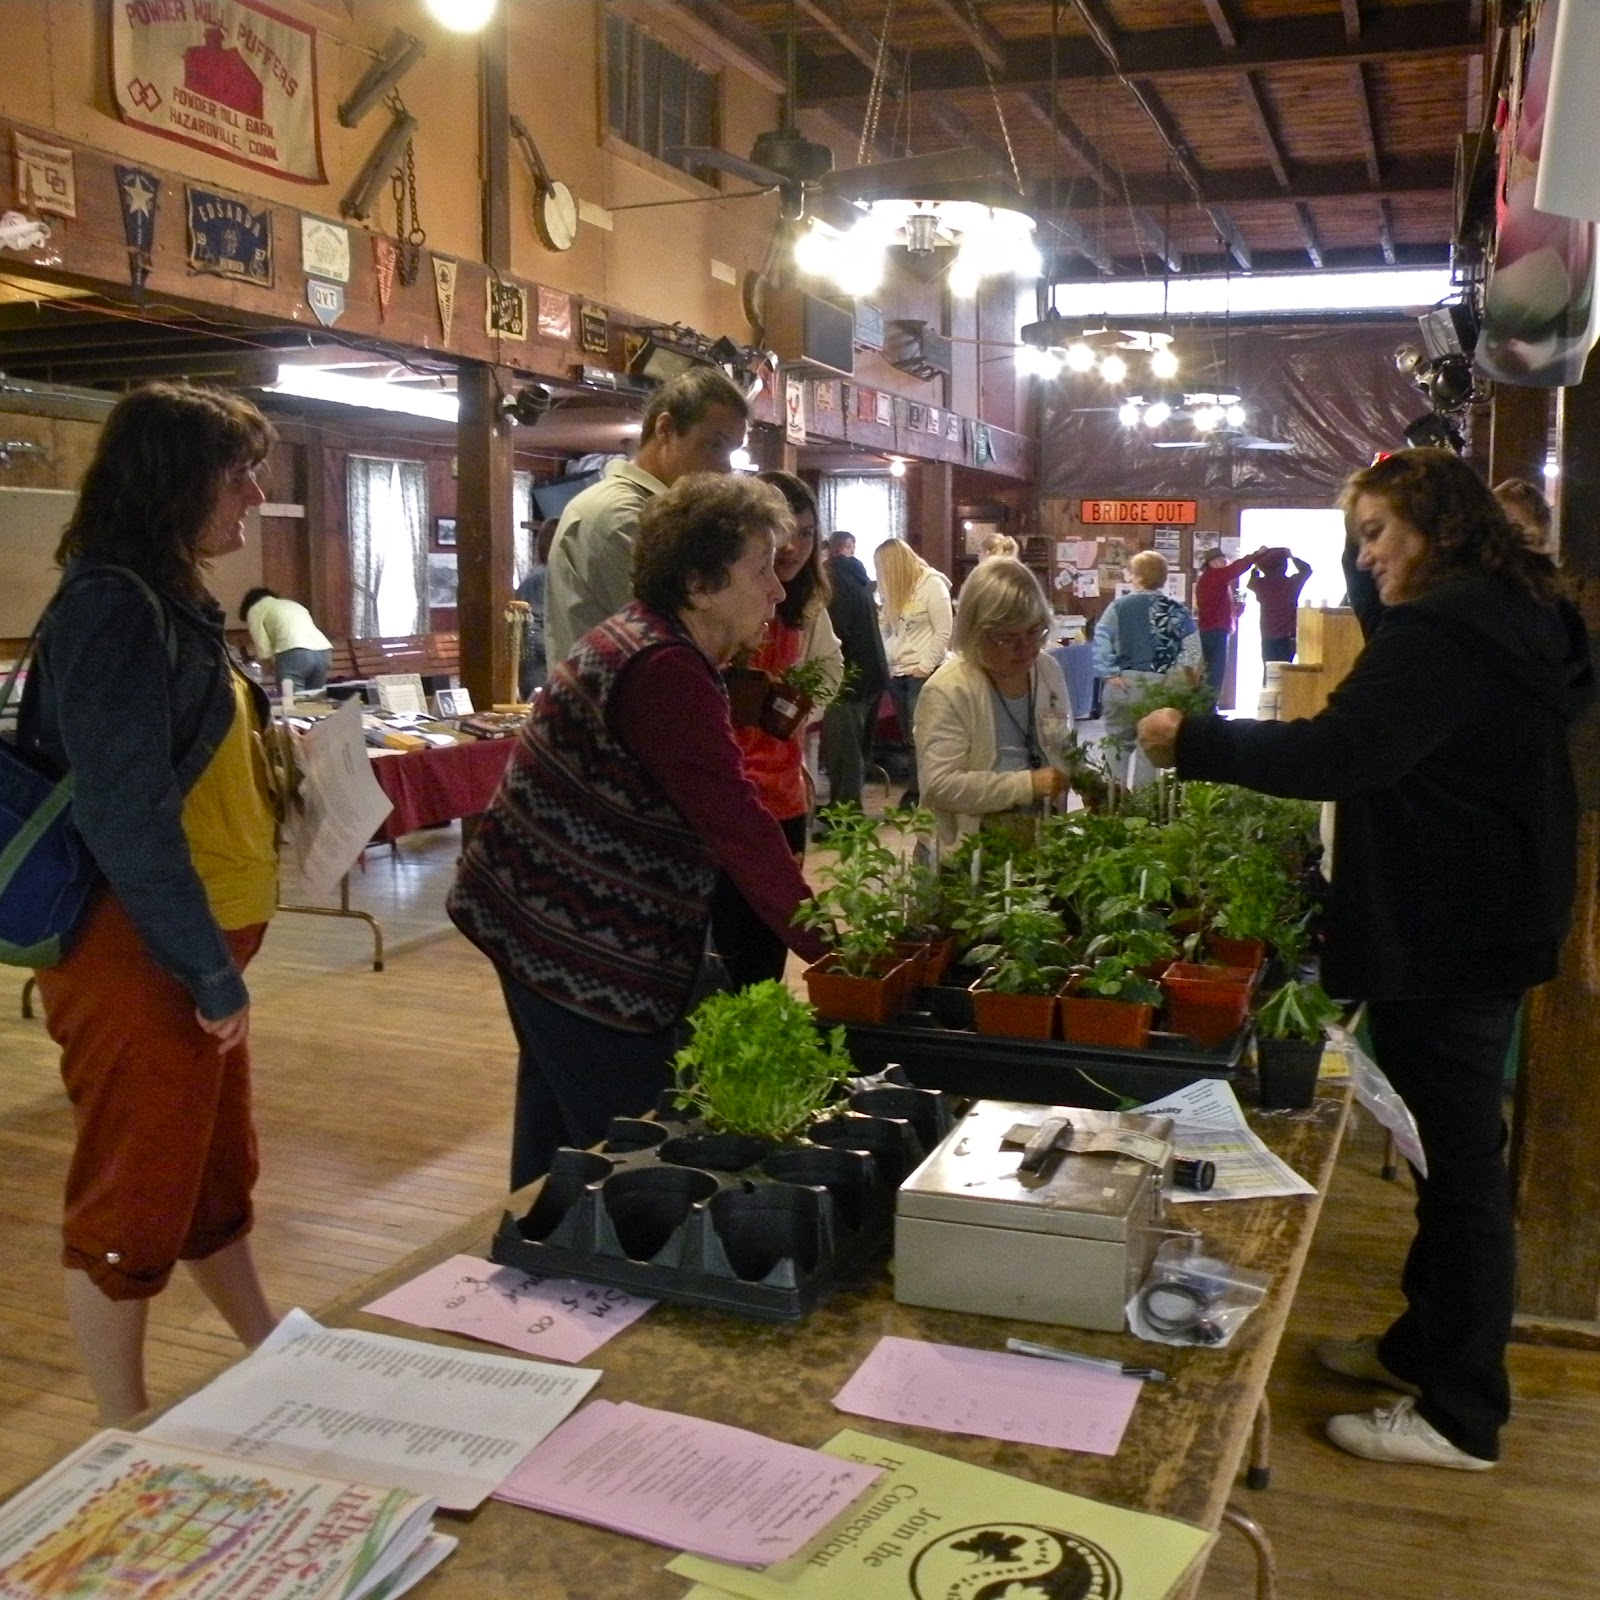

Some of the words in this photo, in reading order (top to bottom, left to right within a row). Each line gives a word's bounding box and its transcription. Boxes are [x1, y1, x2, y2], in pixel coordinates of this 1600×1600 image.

[238, 23, 298, 97] PUFFERS
[173, 86, 216, 118] POWDER
[246, 118, 274, 139] BARN
[1092, 503, 1149, 521] BRIDGE
[1155, 503, 1185, 521] OUT
[807, 1484, 918, 1568] Connecticut
[891, 1507, 942, 1541] Join
[863, 1541, 904, 1568] the
